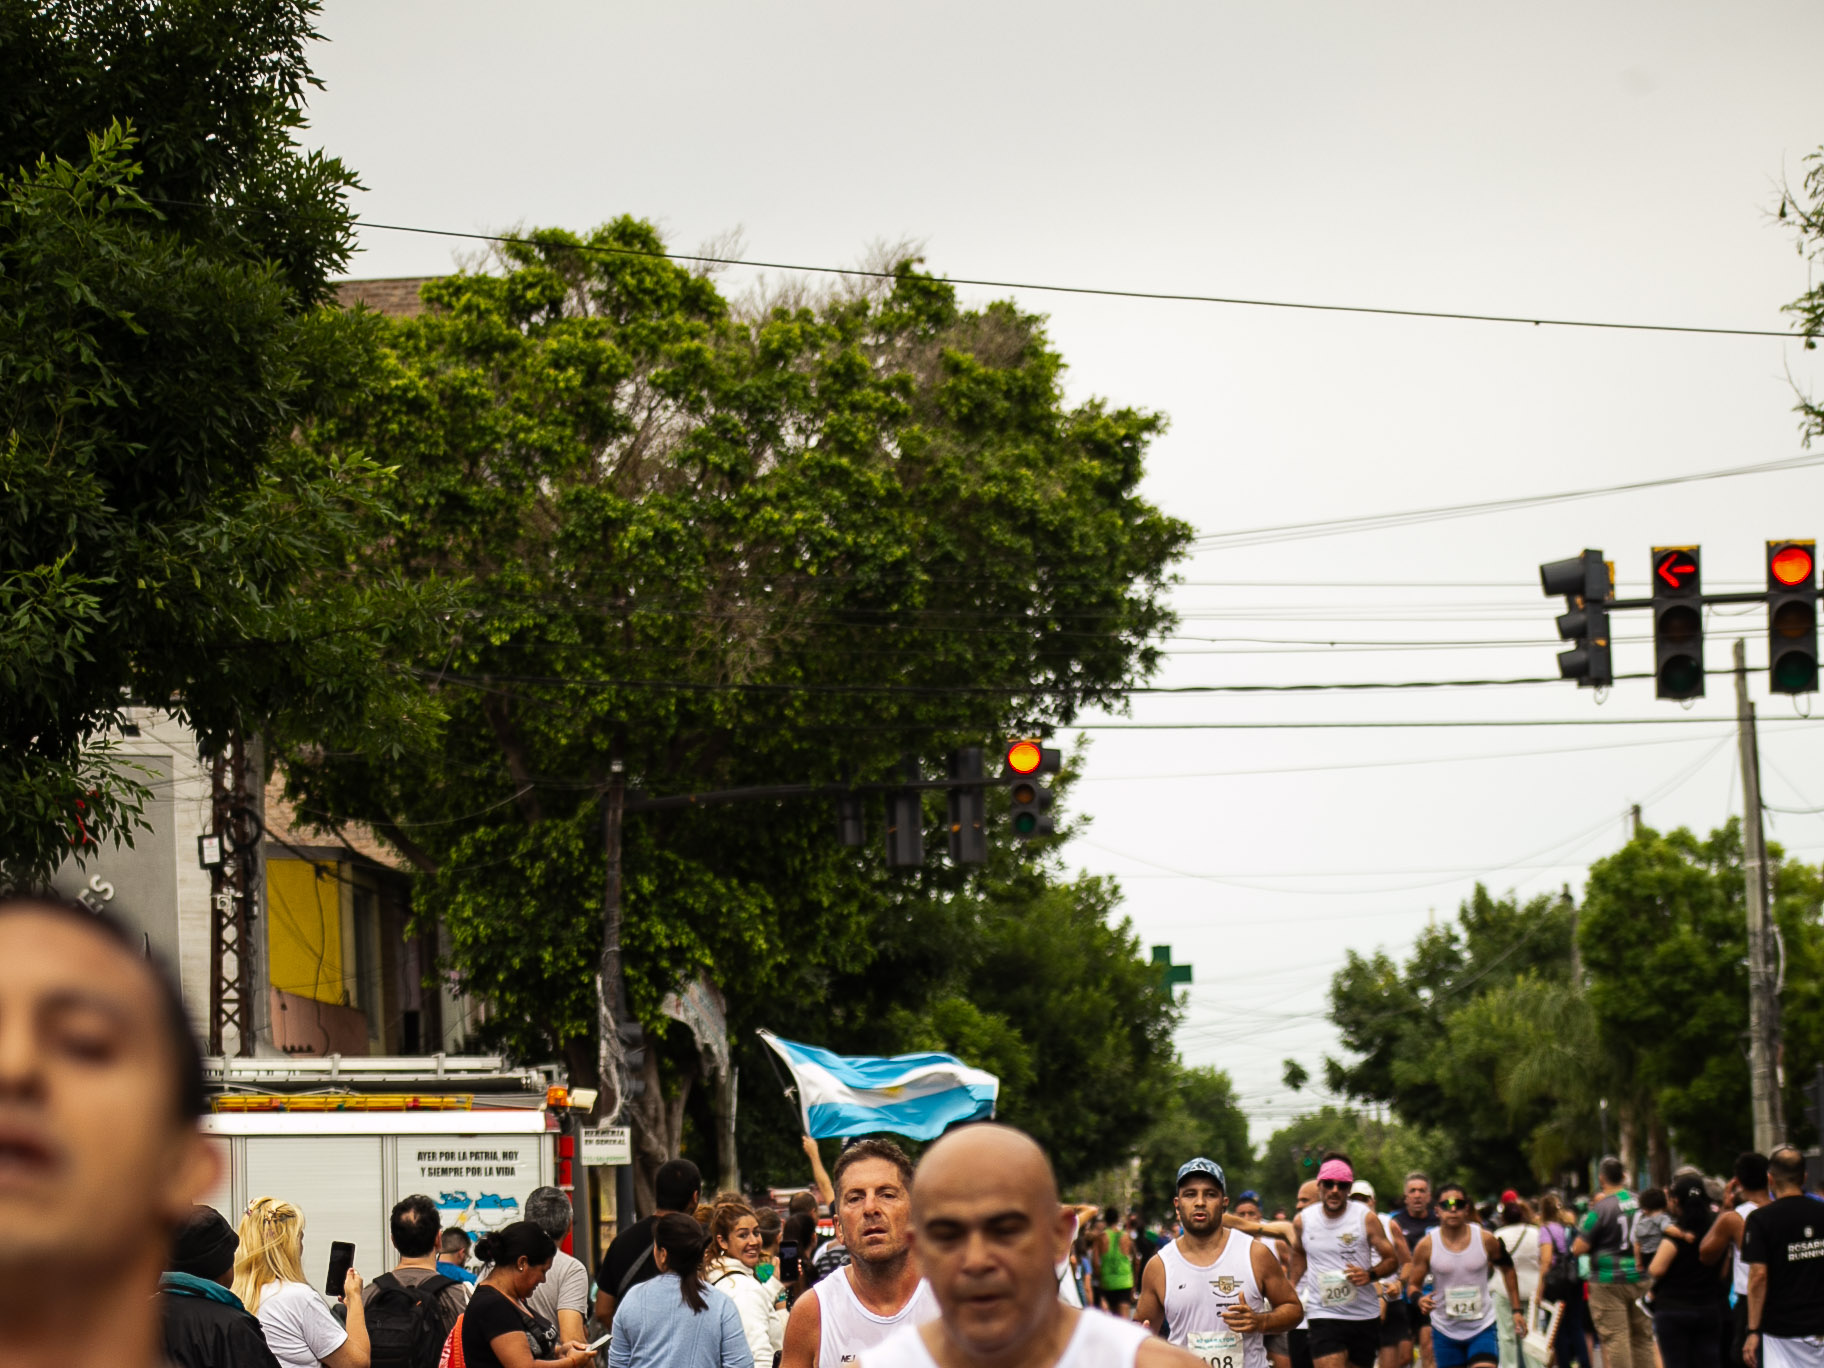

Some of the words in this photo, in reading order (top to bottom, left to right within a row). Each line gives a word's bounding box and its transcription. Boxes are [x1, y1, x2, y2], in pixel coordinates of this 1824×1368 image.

[417, 1151, 437, 1161] AYER
[439, 1151, 456, 1161] POR
[458, 1151, 467, 1161] LA
[469, 1151, 500, 1162] PATRIA,
[502, 1151, 519, 1161] HOY
[421, 1167, 426, 1177] Y
[427, 1167, 464, 1177] SIEMPRE
[465, 1167, 482, 1177] POR
[484, 1167, 494, 1177] LA
[496, 1167, 516, 1177] VIDA
[1326, 1285, 1351, 1299] 200
